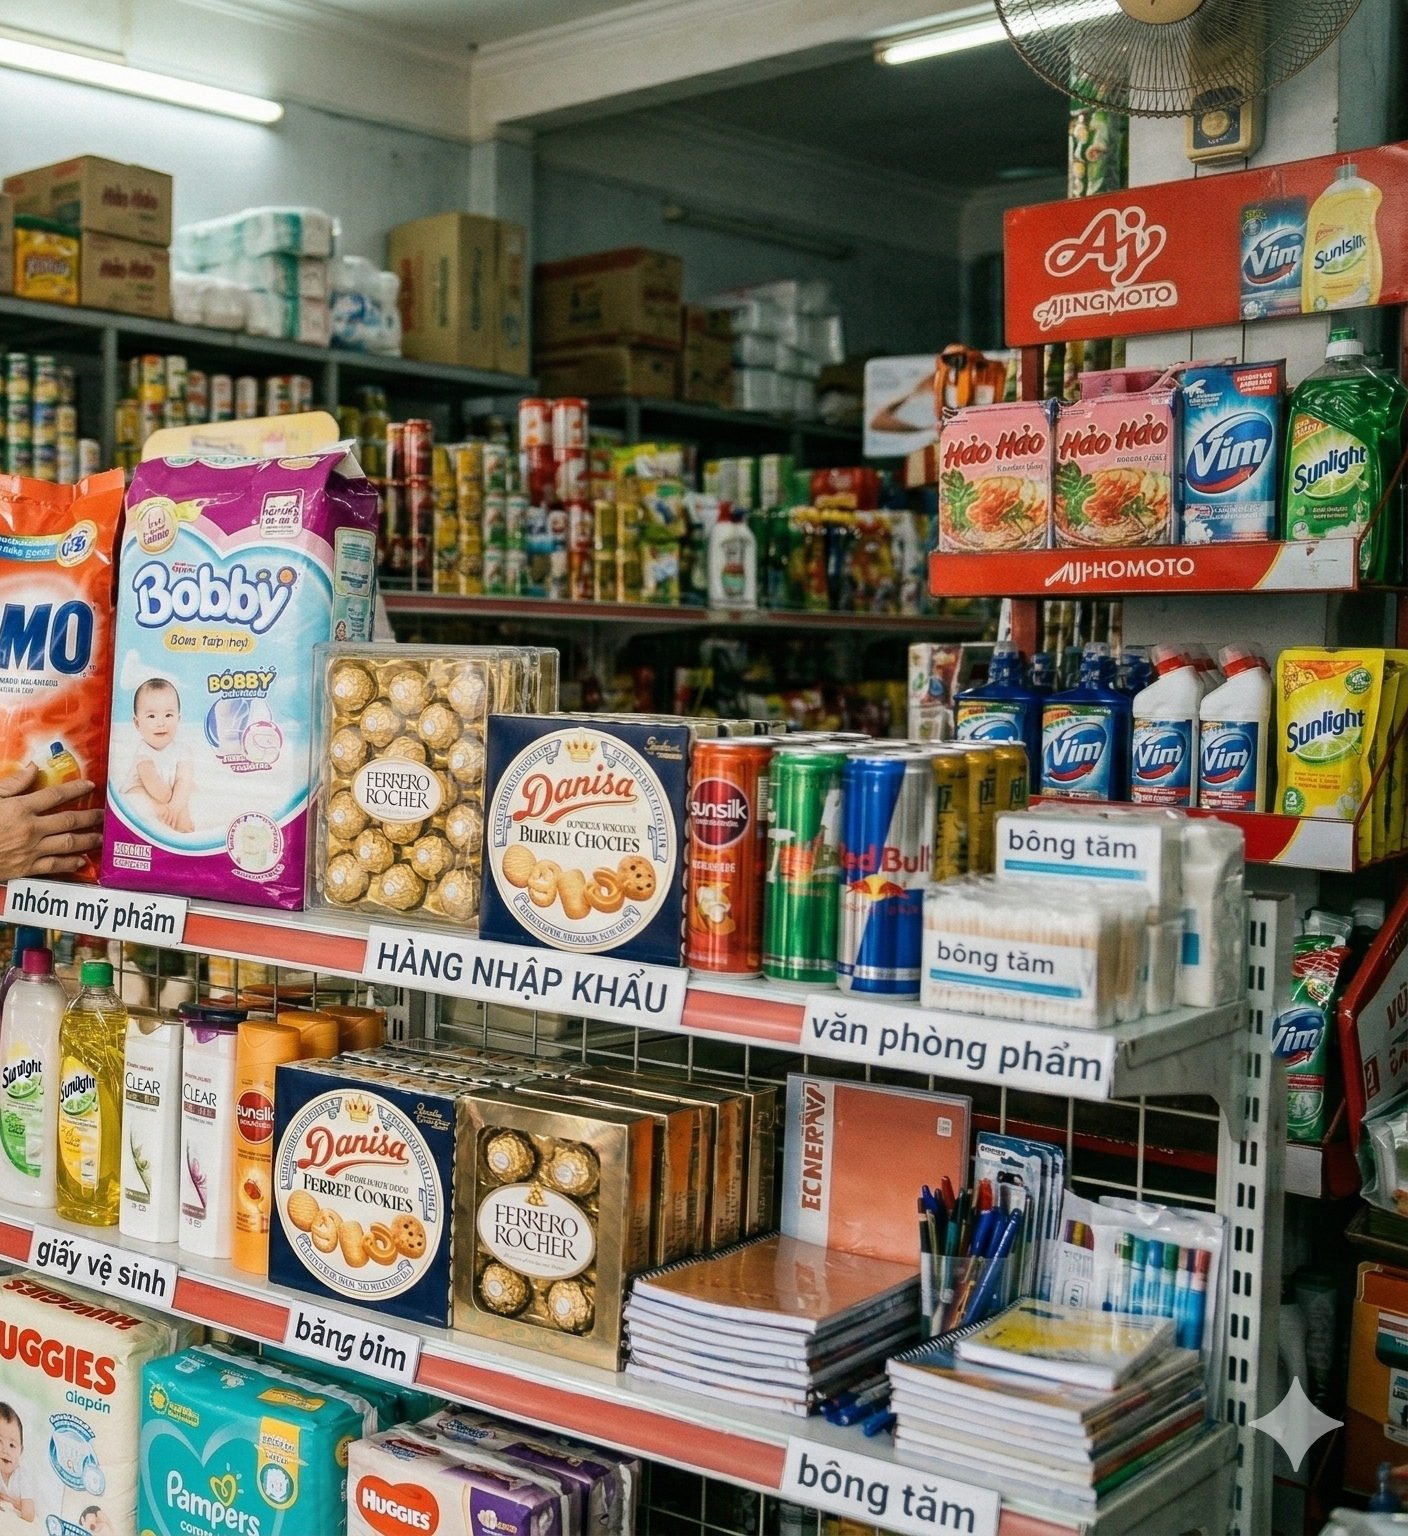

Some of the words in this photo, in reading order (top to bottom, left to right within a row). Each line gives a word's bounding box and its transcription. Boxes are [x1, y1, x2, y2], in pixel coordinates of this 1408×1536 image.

[1250, 245, 1301, 276] Vim
[944, 435, 993, 468] Hảo
[996, 424, 1045, 459] Hảo
[1059, 425, 1112, 459] Hảo
[1115, 414, 1168, 450] Hảo
[1193, 435, 1267, 477] Vim
[1293, 446, 1367, 496] Sunlight
[133, 561, 295, 634] Bobby
[1287, 708, 1366, 753] Sunlight
[1053, 739, 1102, 766] Vim
[1139, 745, 1182, 768] Vim
[1204, 749, 1248, 771] Vim
[366, 771, 430, 792] FERRERO
[366, 788, 430, 810] ROCHER
[512, 764, 639, 825] Danisa
[691, 799, 747, 820] sunsilk
[881, 845, 930, 873] Bull
[1009, 829, 1075, 860] bông
[1086, 835, 1137, 859] tăm
[11, 887, 68, 917] nhóm
[75, 898, 108, 930] mỹ
[112, 902, 175, 934] phẩm
[377, 938, 463, 981] HÀNG
[472, 957, 563, 1001] NHẬP
[572, 968, 668, 1013] KHẨU
[938, 940, 998, 971] bông
[1008, 951, 1054, 975] tăm
[812, 1011, 868, 1045] văn
[879, 1022, 987, 1070] phòng
[998, 1039, 1103, 1082] phẩm
[125, 1072, 161, 1095] CLEAR
[184, 1083, 217, 1107] CLEAR
[297, 1126, 409, 1178] Danisa
[355, 1185, 413, 1213] COOKIES
[495, 1203, 578, 1238] FERRERO
[495, 1224, 577, 1260] ROCHER
[36, 1239, 82, 1275] giấy
[88, 1253, 112, 1286] vệ
[118, 1263, 167, 1297] sinh
[295, 1312, 356, 1362] băng
[166, 1470, 261, 1536] Pampers
[362, 1487, 432, 1531] HUGGIES
[797, 1453, 889, 1516] bông
[902, 1484, 975, 1534] tăm
